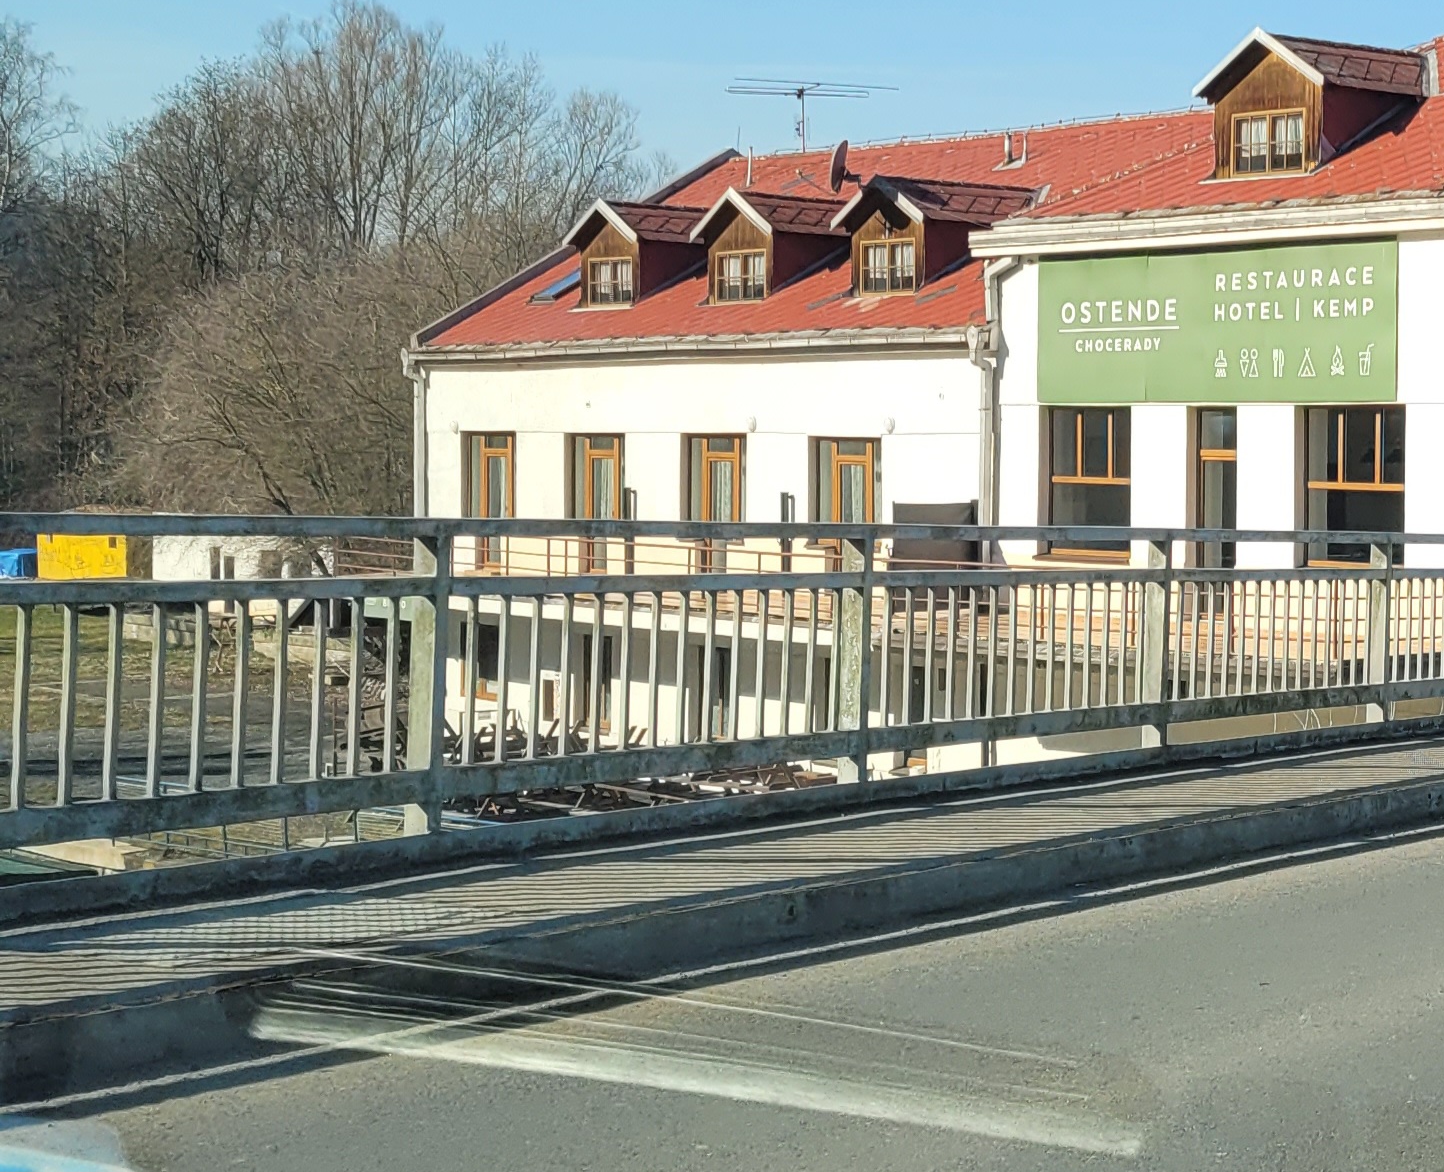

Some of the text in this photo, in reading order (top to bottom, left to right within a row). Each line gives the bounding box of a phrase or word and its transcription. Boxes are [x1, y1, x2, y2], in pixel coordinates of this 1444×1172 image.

[1215, 266, 1375, 292] RESTAURACE
[1061, 298, 1178, 324] OSTENDE
[1214, 297, 1375, 322] HOTEL KEMP
[1075, 337, 1161, 353] CHOCERADY
